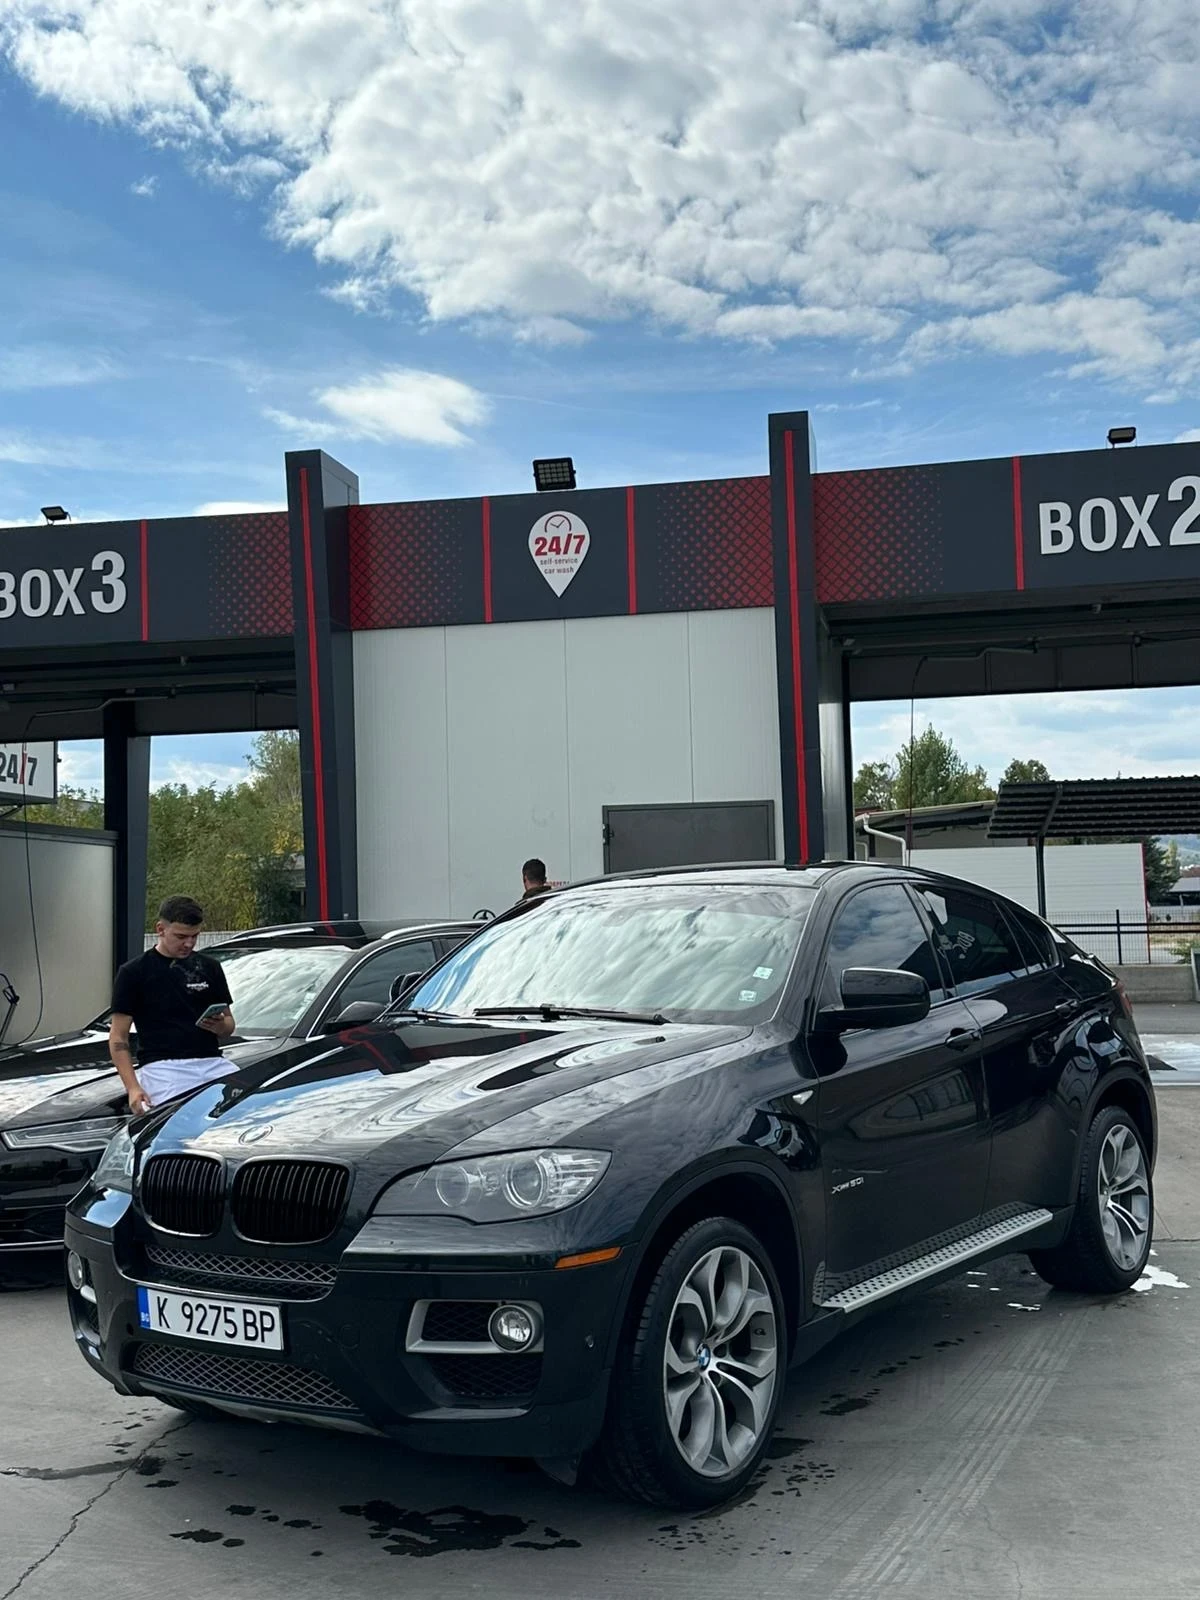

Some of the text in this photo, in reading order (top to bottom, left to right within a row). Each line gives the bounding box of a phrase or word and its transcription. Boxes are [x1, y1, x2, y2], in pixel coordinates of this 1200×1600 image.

[534, 533, 586, 556] 24/7
[540, 557, 578, 566] self-service
[544, 566, 574, 575] car wash
[156, 1296, 275, 1343] K 9275 BP
